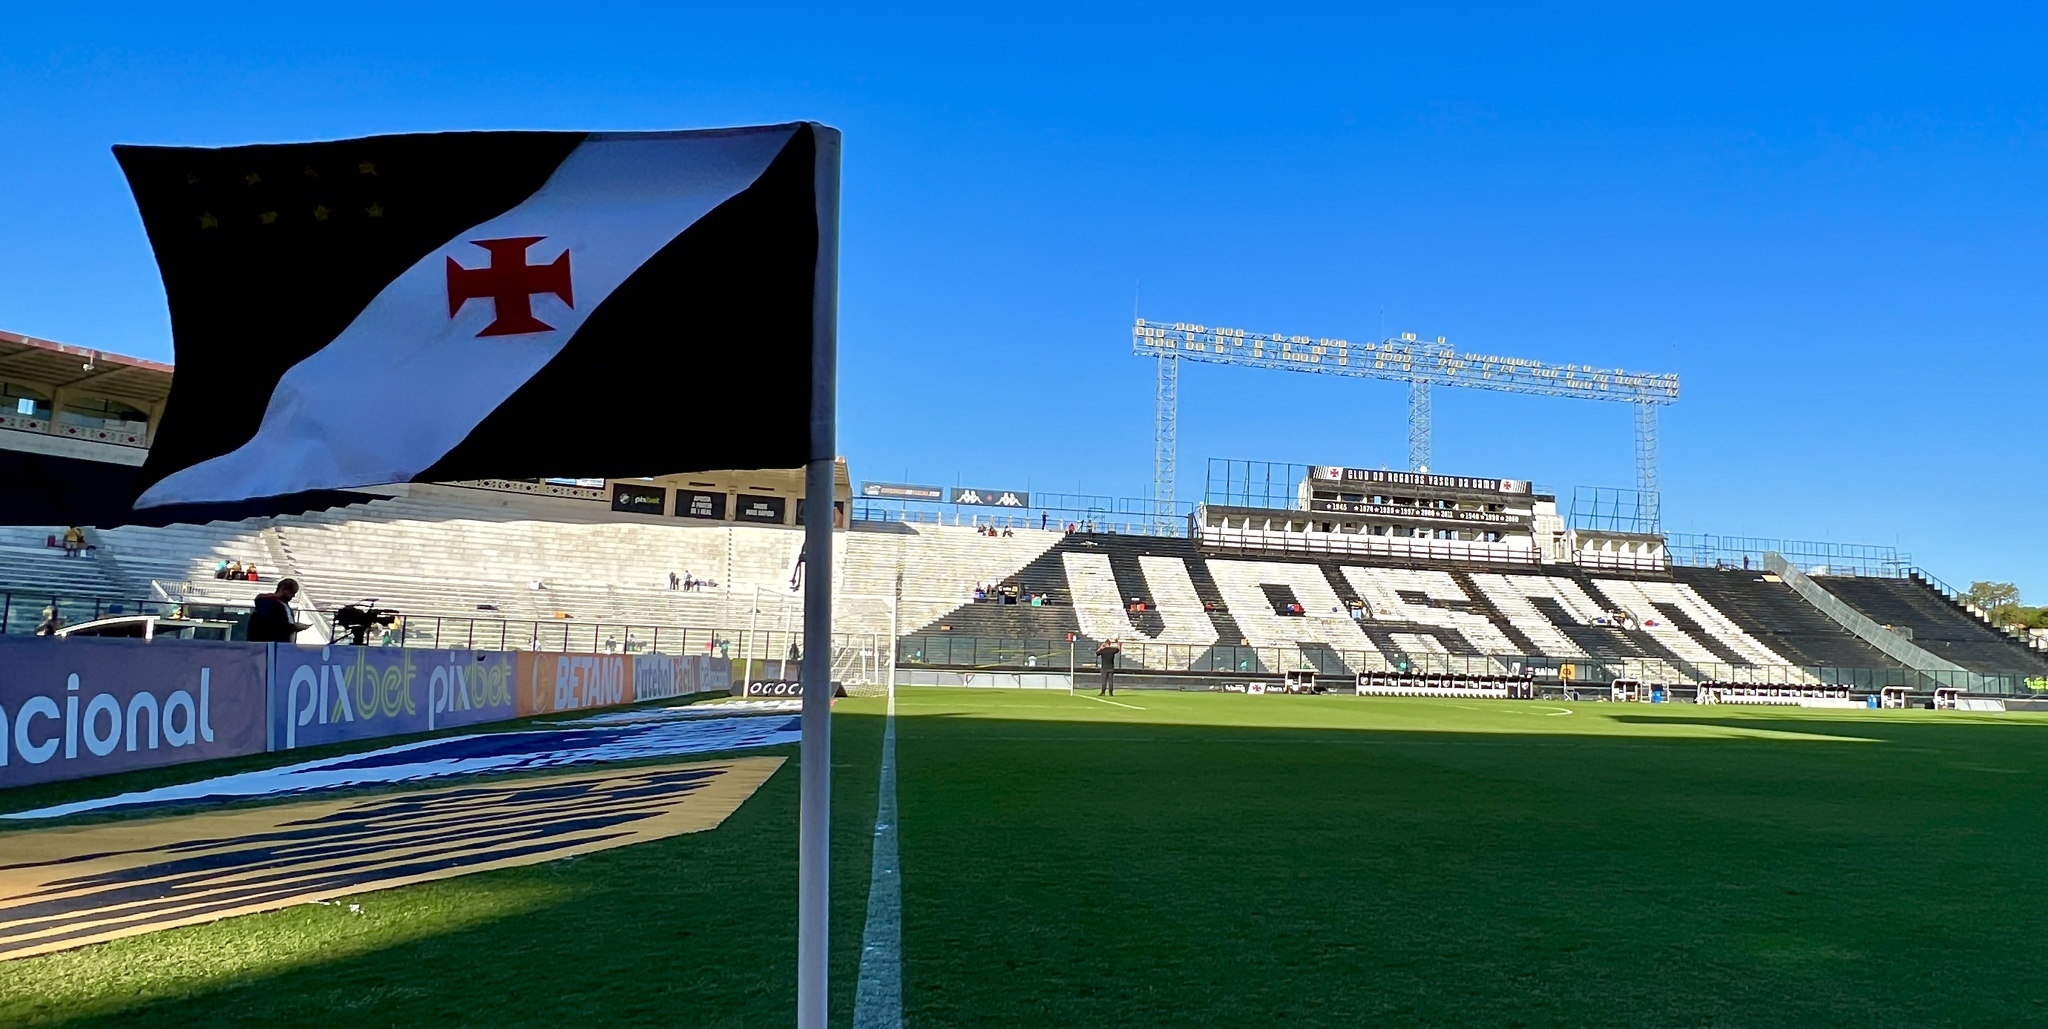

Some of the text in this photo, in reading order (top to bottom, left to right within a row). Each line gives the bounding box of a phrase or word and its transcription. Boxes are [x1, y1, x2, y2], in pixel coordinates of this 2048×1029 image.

[634, 496, 660, 504] pixbet
[1347, 469, 1495, 490] CLUB DE REGATAS VASCO DA GAMA
[1062, 552, 1822, 684] VASCO
[0, 667, 214, 766] cional
[286, 645, 417, 749] pixbet
[428, 650, 512, 731] pixbet
[554, 656, 624, 710] BETANO
